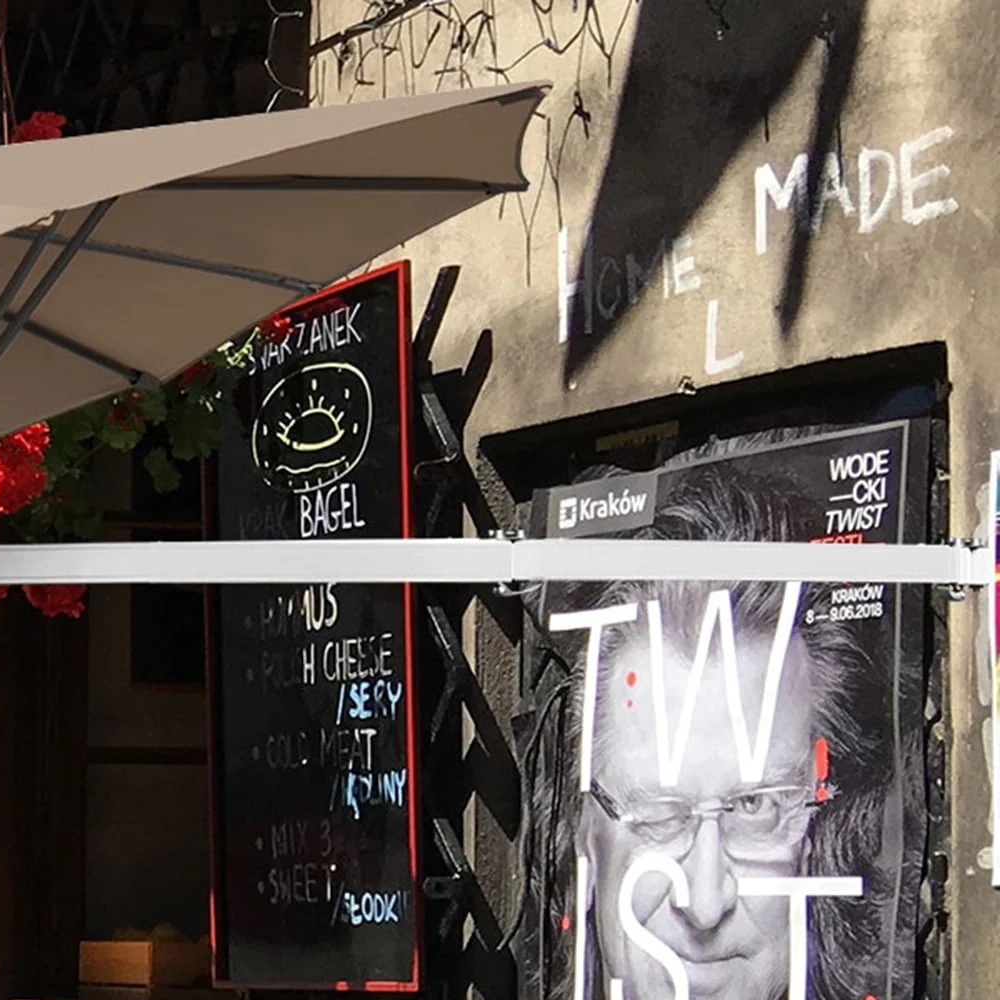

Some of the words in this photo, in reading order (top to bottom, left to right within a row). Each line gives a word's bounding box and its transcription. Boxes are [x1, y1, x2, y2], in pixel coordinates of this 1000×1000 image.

[754, 125, 959, 255] MADE
[830, 449, 890, 482] WODE
[300, 483, 366, 538] BAGEL
[580, 488, 647, 521] Kraków
[826, 503, 888, 534] TWIST
[832, 584, 884, 604] KRAKÓW
[323, 632, 394, 682] CHEESE
